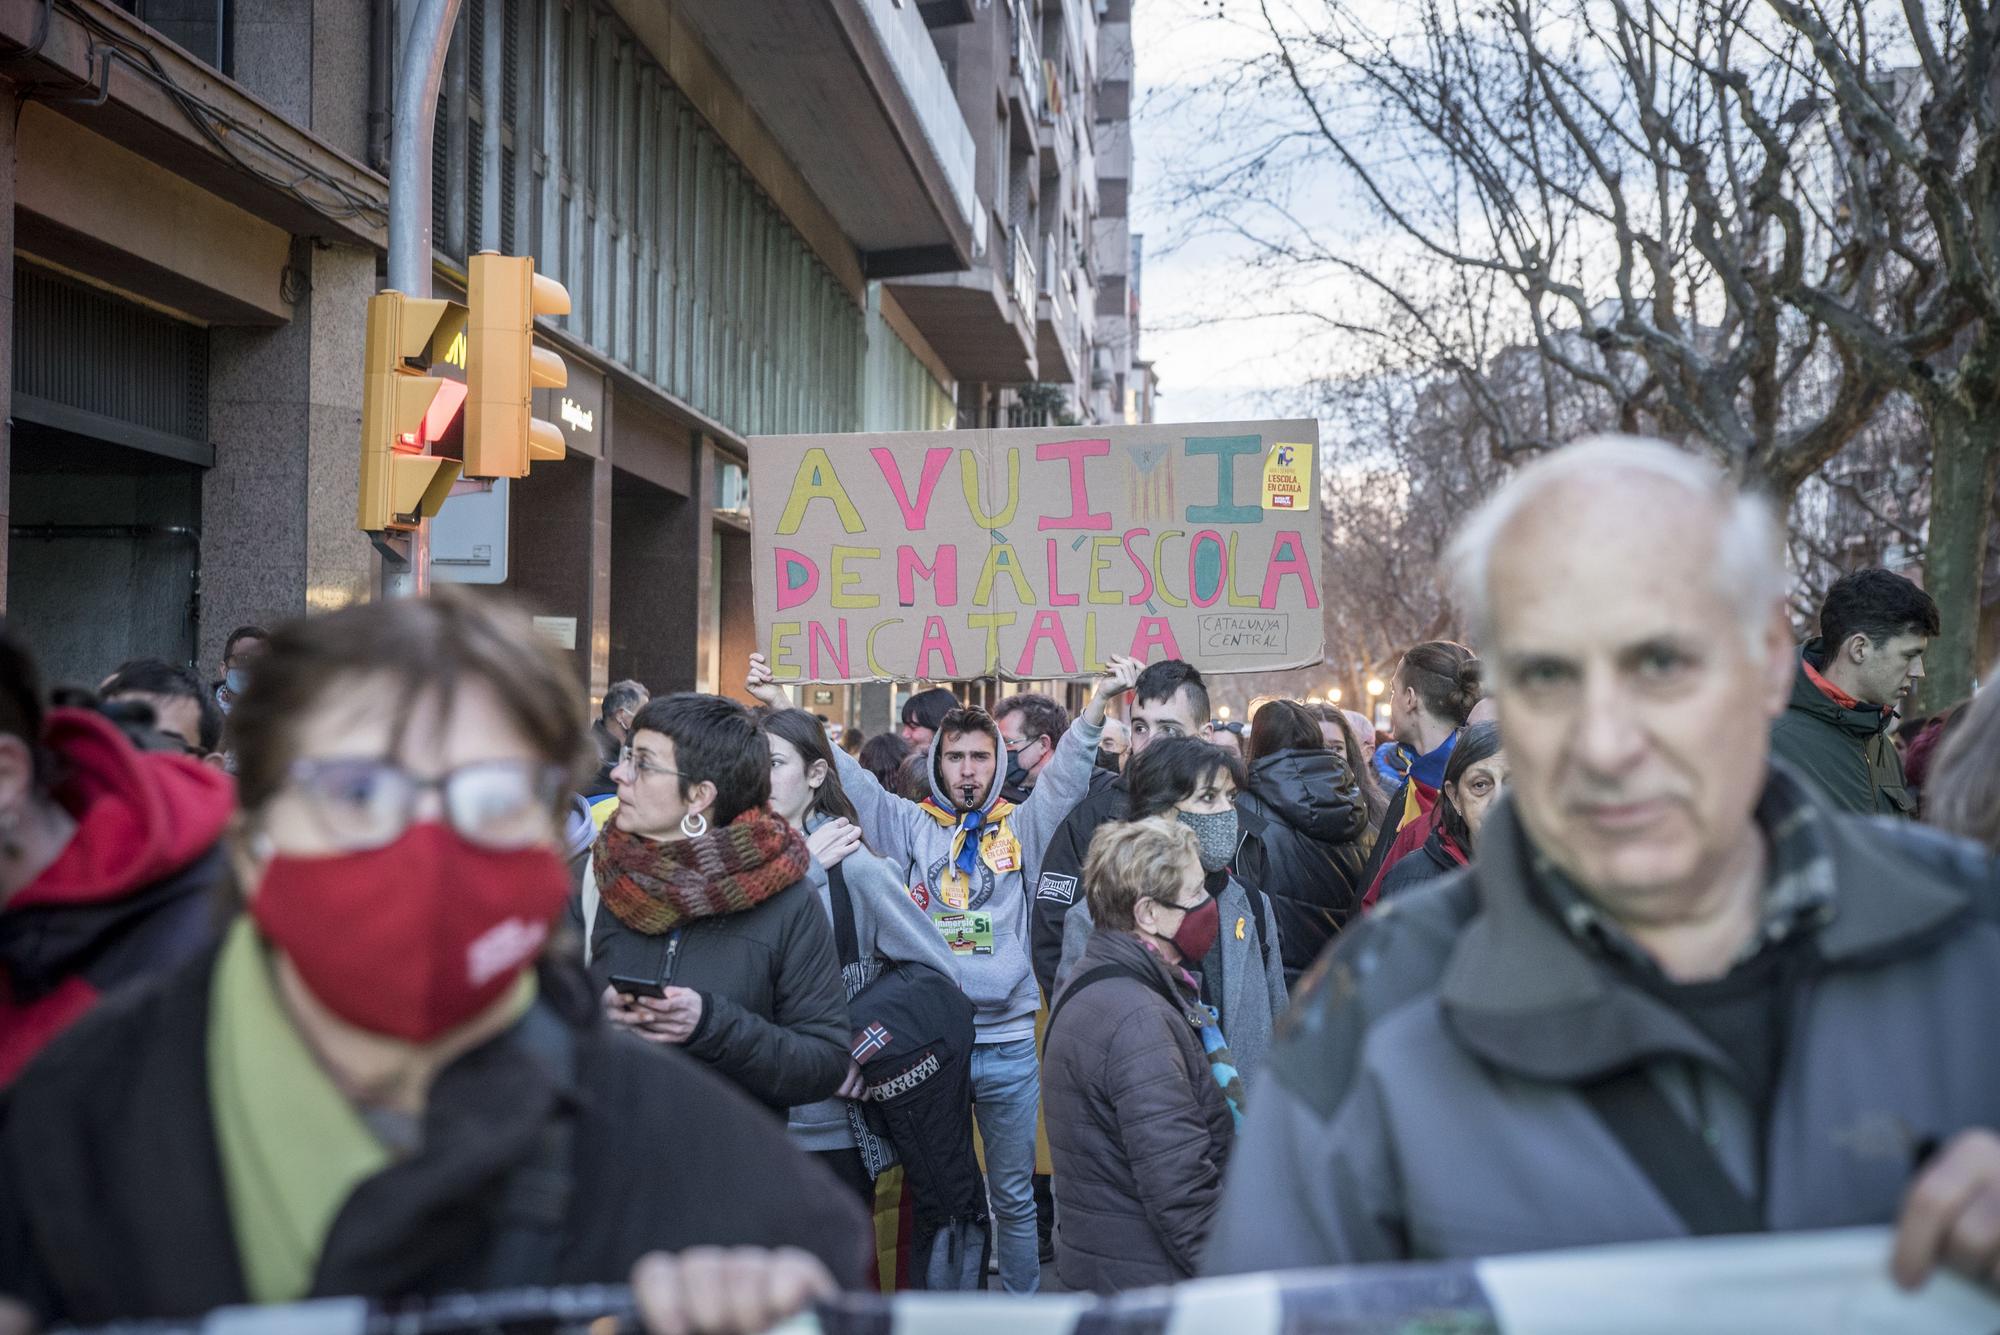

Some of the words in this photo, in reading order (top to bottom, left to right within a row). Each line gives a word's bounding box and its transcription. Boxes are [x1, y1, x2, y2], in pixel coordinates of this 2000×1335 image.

[774, 439, 1112, 535] AVUI
[1183, 435, 1264, 523] I
[1268, 474, 1297, 484] L'ESCOLA
[1268, 483, 1276, 491] EN
[1277, 482, 1302, 493] CATALÀ
[774, 529, 1037, 612] DEMÀ
[1047, 528, 1320, 610] L'ESCOLA
[1203, 616, 1281, 632] CATALUNYA
[770, 617, 850, 680] EN
[866, 600, 1184, 680] CATALÀ
[1208, 632, 1279, 648] CENTRAL
